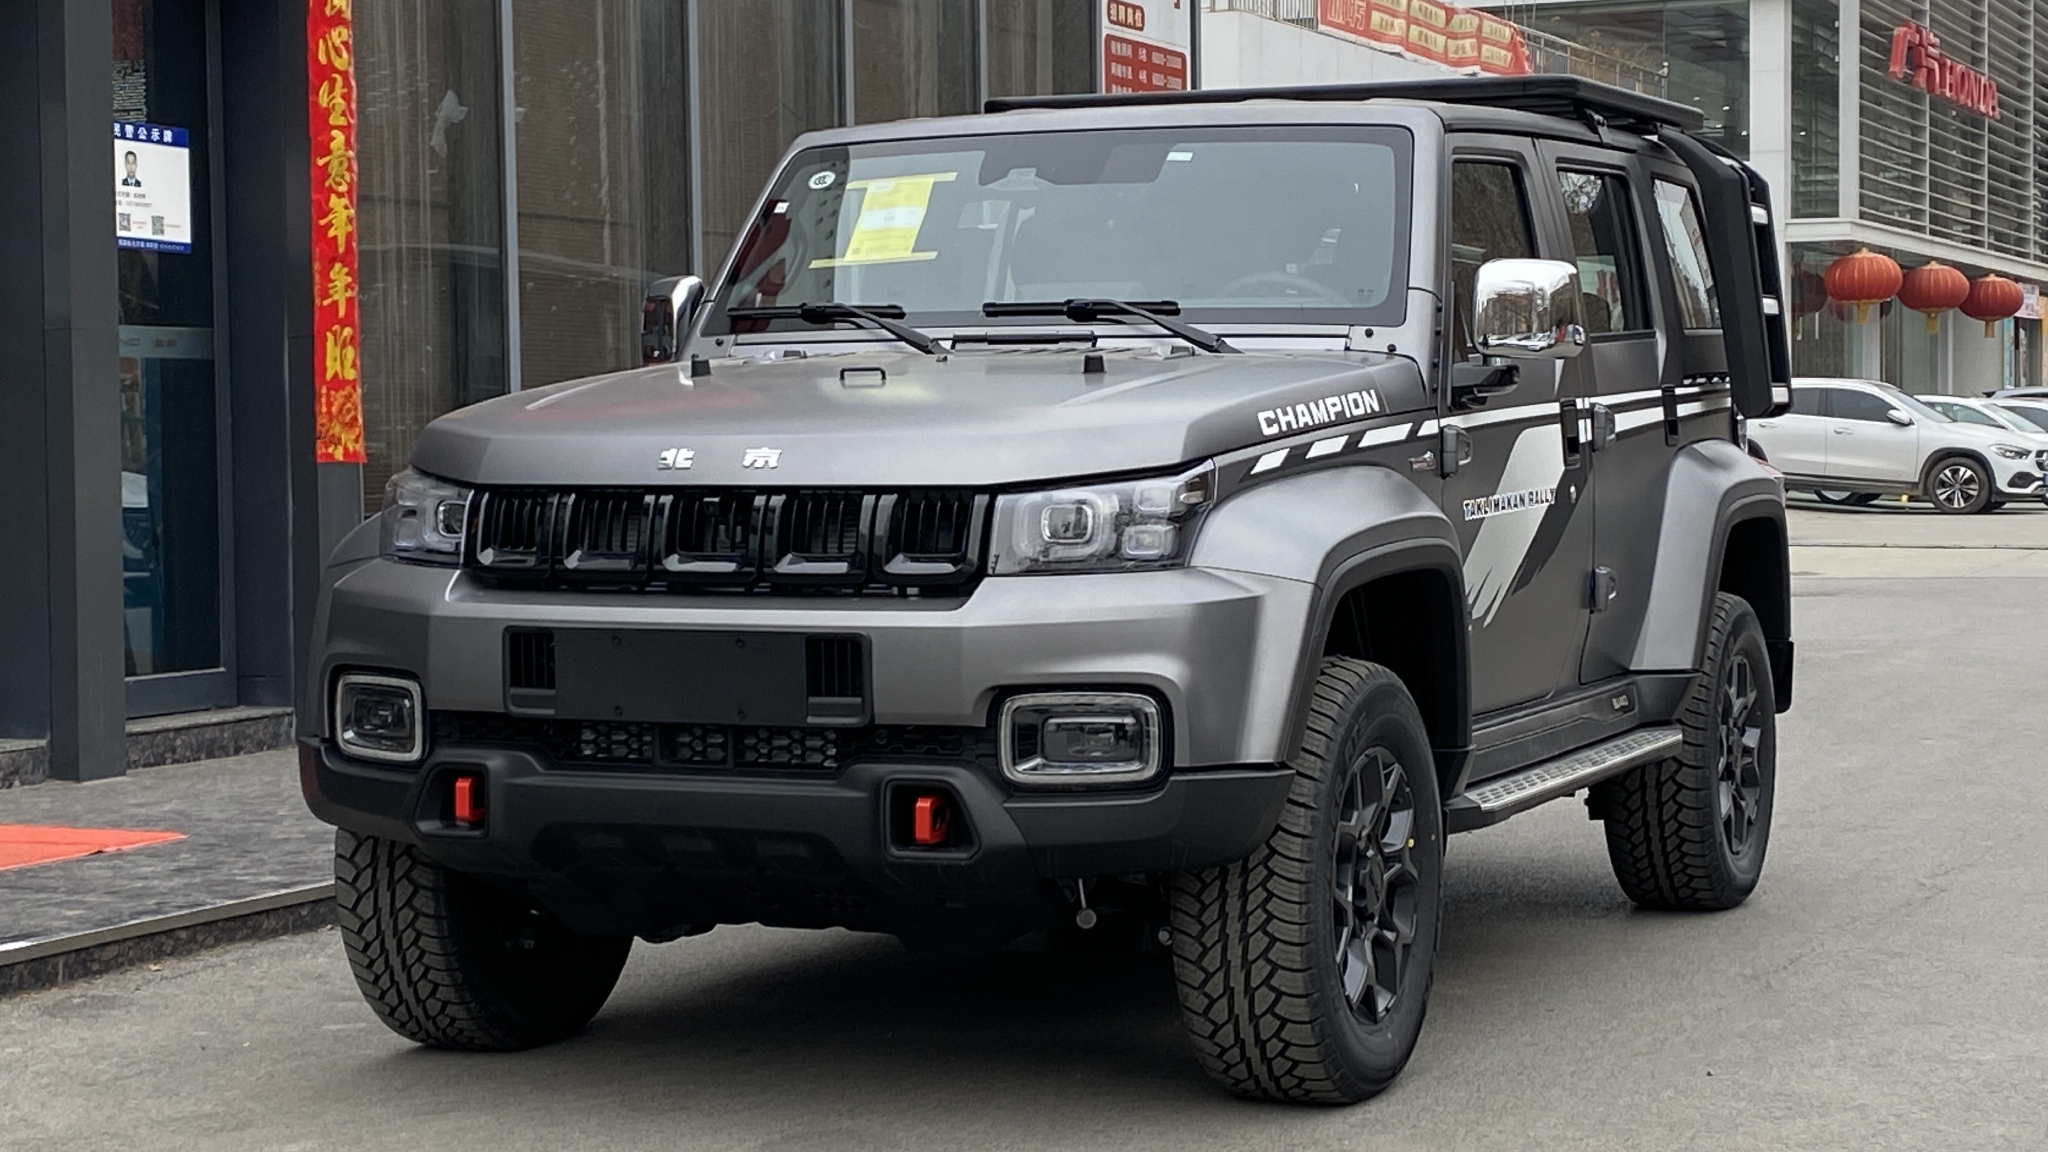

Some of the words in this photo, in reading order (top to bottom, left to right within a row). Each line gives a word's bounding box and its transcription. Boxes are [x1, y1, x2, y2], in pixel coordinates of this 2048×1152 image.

[1940, 58, 2001, 120] HONDA
[1257, 389, 1380, 436] CHAMPION
[657, 446, 783, 470] 北京
[1463, 494, 1526, 521] TAKLIMAKAN
[1527, 487, 1556, 509] RALLY
